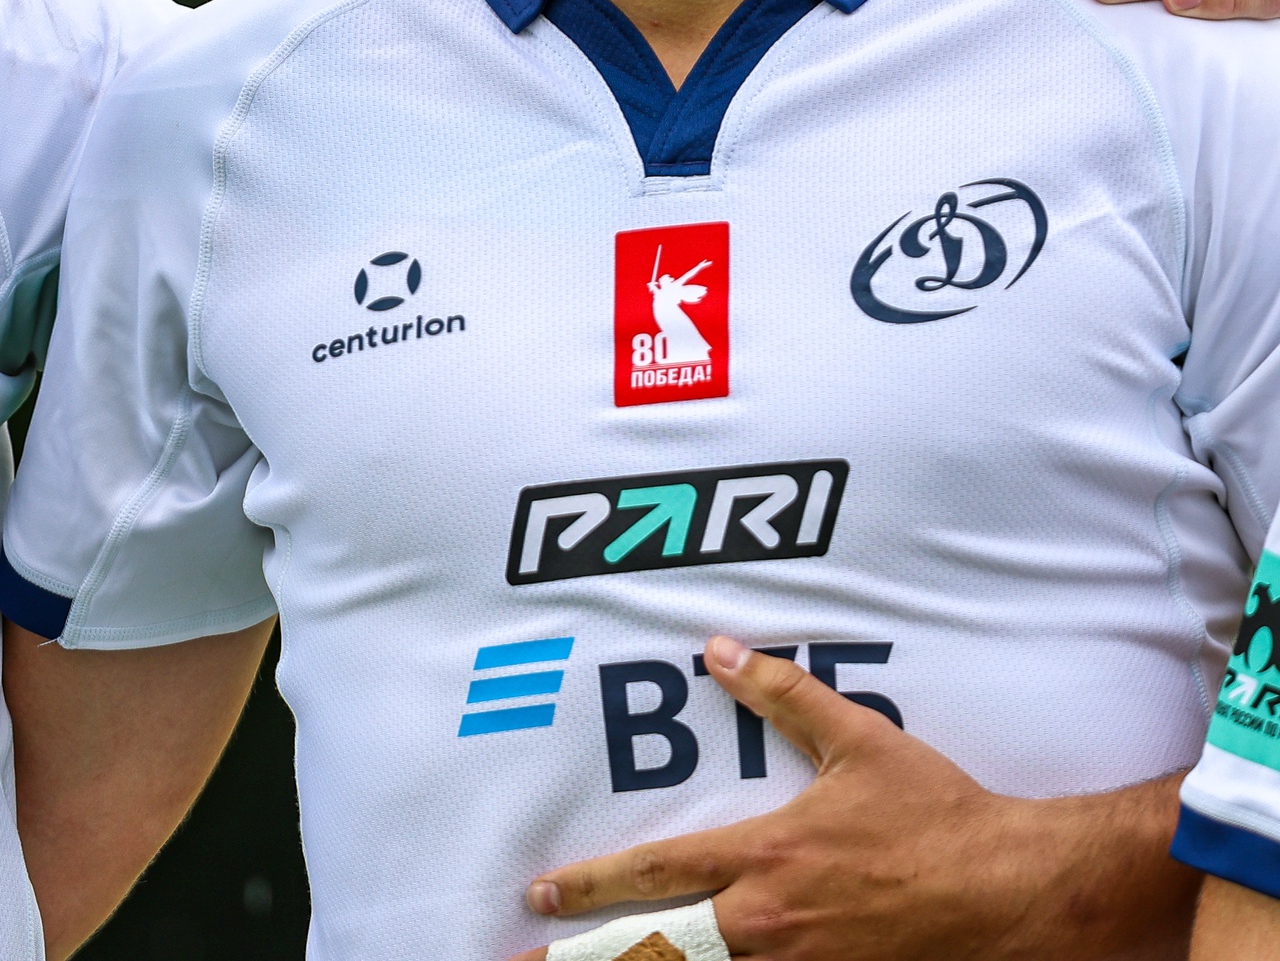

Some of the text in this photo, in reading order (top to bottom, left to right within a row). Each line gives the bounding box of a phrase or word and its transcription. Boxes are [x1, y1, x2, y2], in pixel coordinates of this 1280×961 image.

[312, 314, 466, 363] centurion
[631, 331, 669, 367] 80
[630, 364, 713, 390] ПОБЕДА!
[518, 469, 835, 574] PARI
